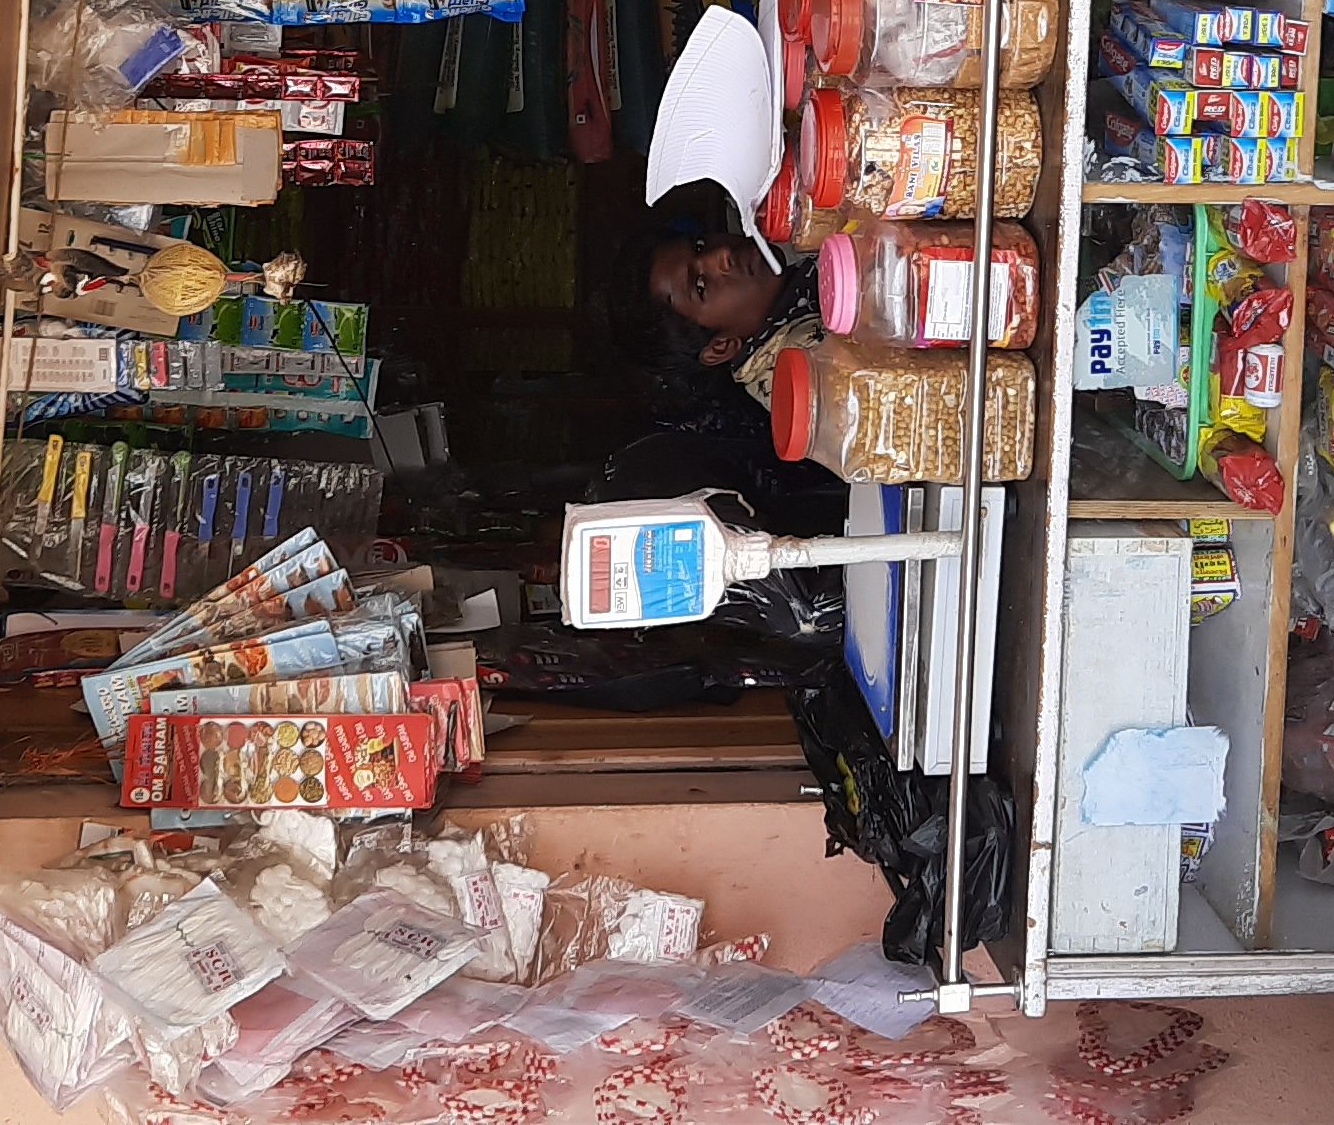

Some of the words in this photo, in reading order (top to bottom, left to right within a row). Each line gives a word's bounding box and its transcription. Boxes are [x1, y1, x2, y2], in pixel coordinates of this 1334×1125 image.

[910, 133, 921, 167] VILAS
[1115, 289, 1125, 318] Here
[1083, 291, 1112, 375] paytm
[1115, 321, 1127, 375] Accepted
[153, 717, 167, 774] SAIRAM
[151, 779, 164, 801] OM
